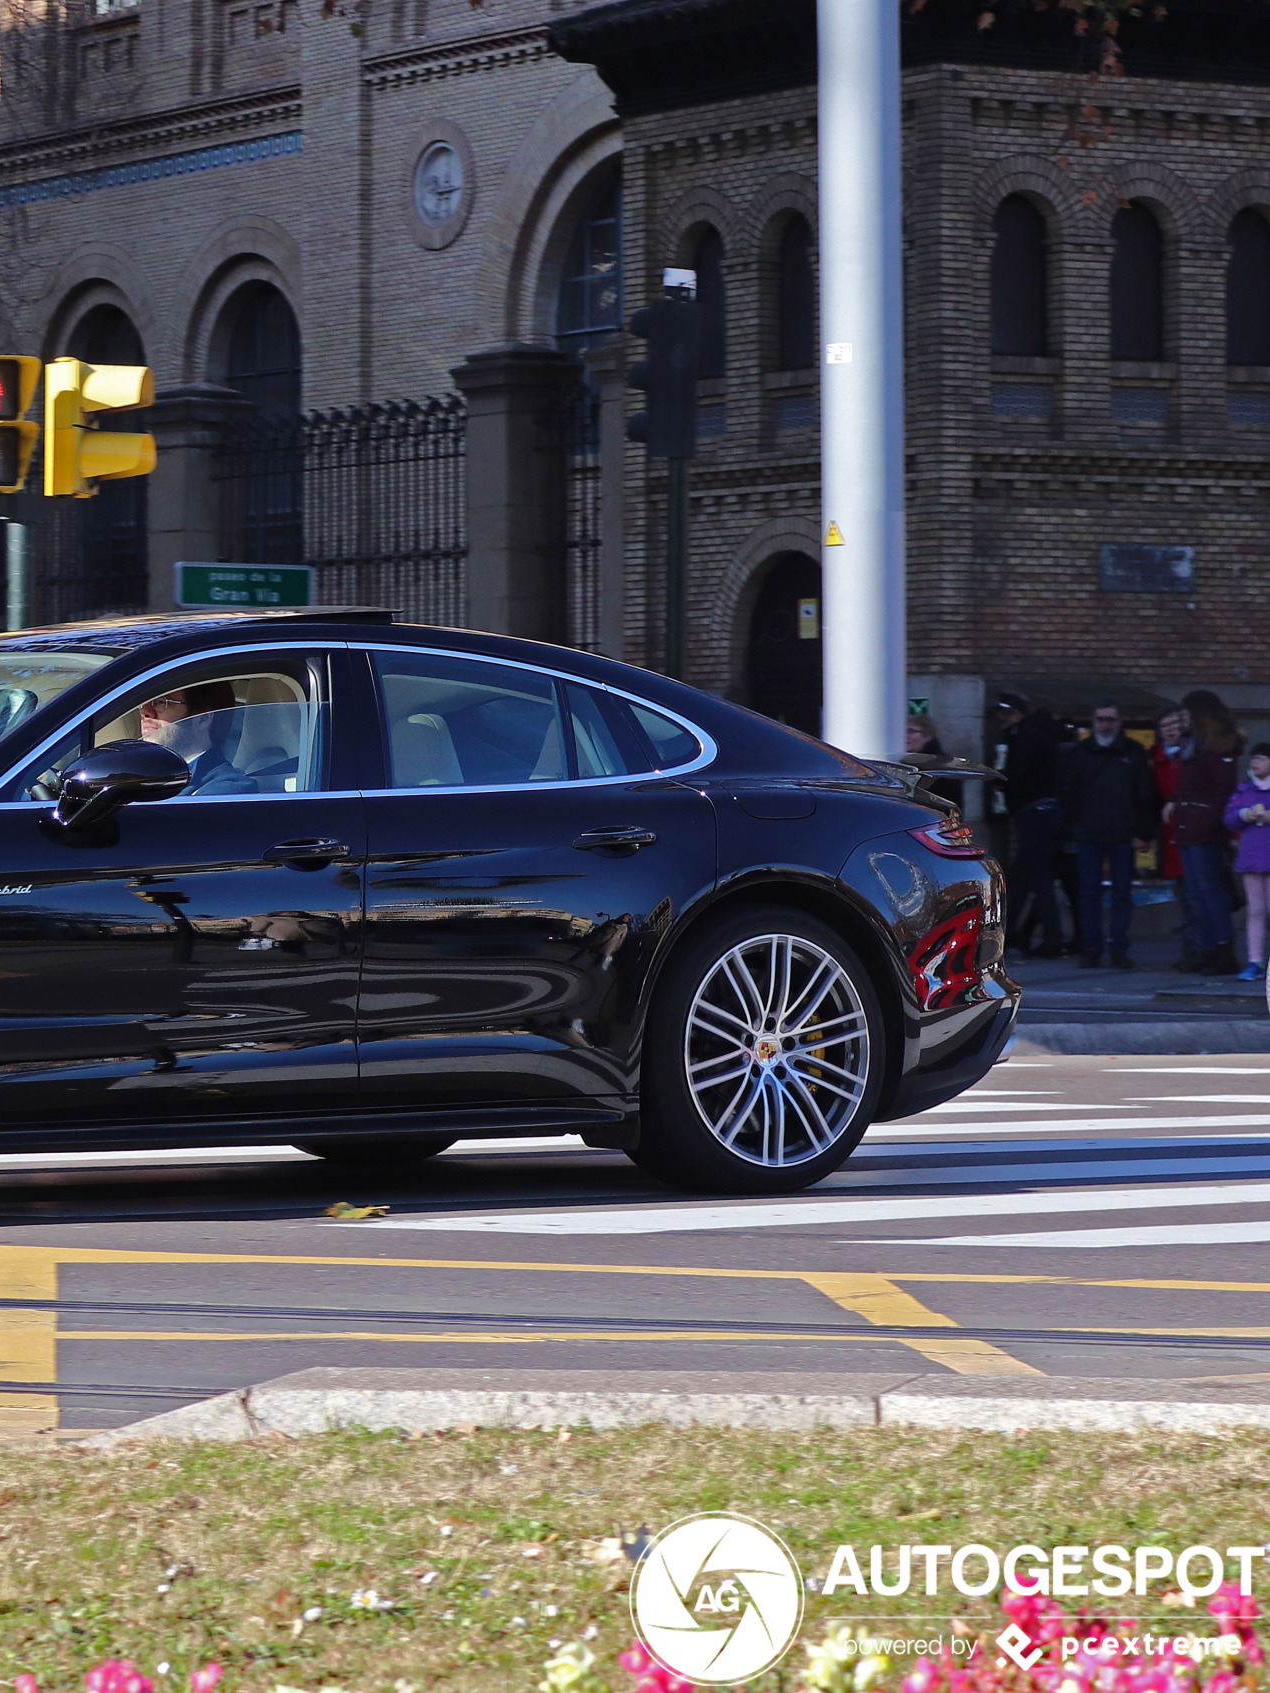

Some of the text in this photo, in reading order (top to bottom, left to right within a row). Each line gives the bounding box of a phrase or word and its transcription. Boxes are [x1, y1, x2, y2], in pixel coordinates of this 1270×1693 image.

[209, 572, 283, 583] paseo de la
[210, 587, 250, 602] Gran
